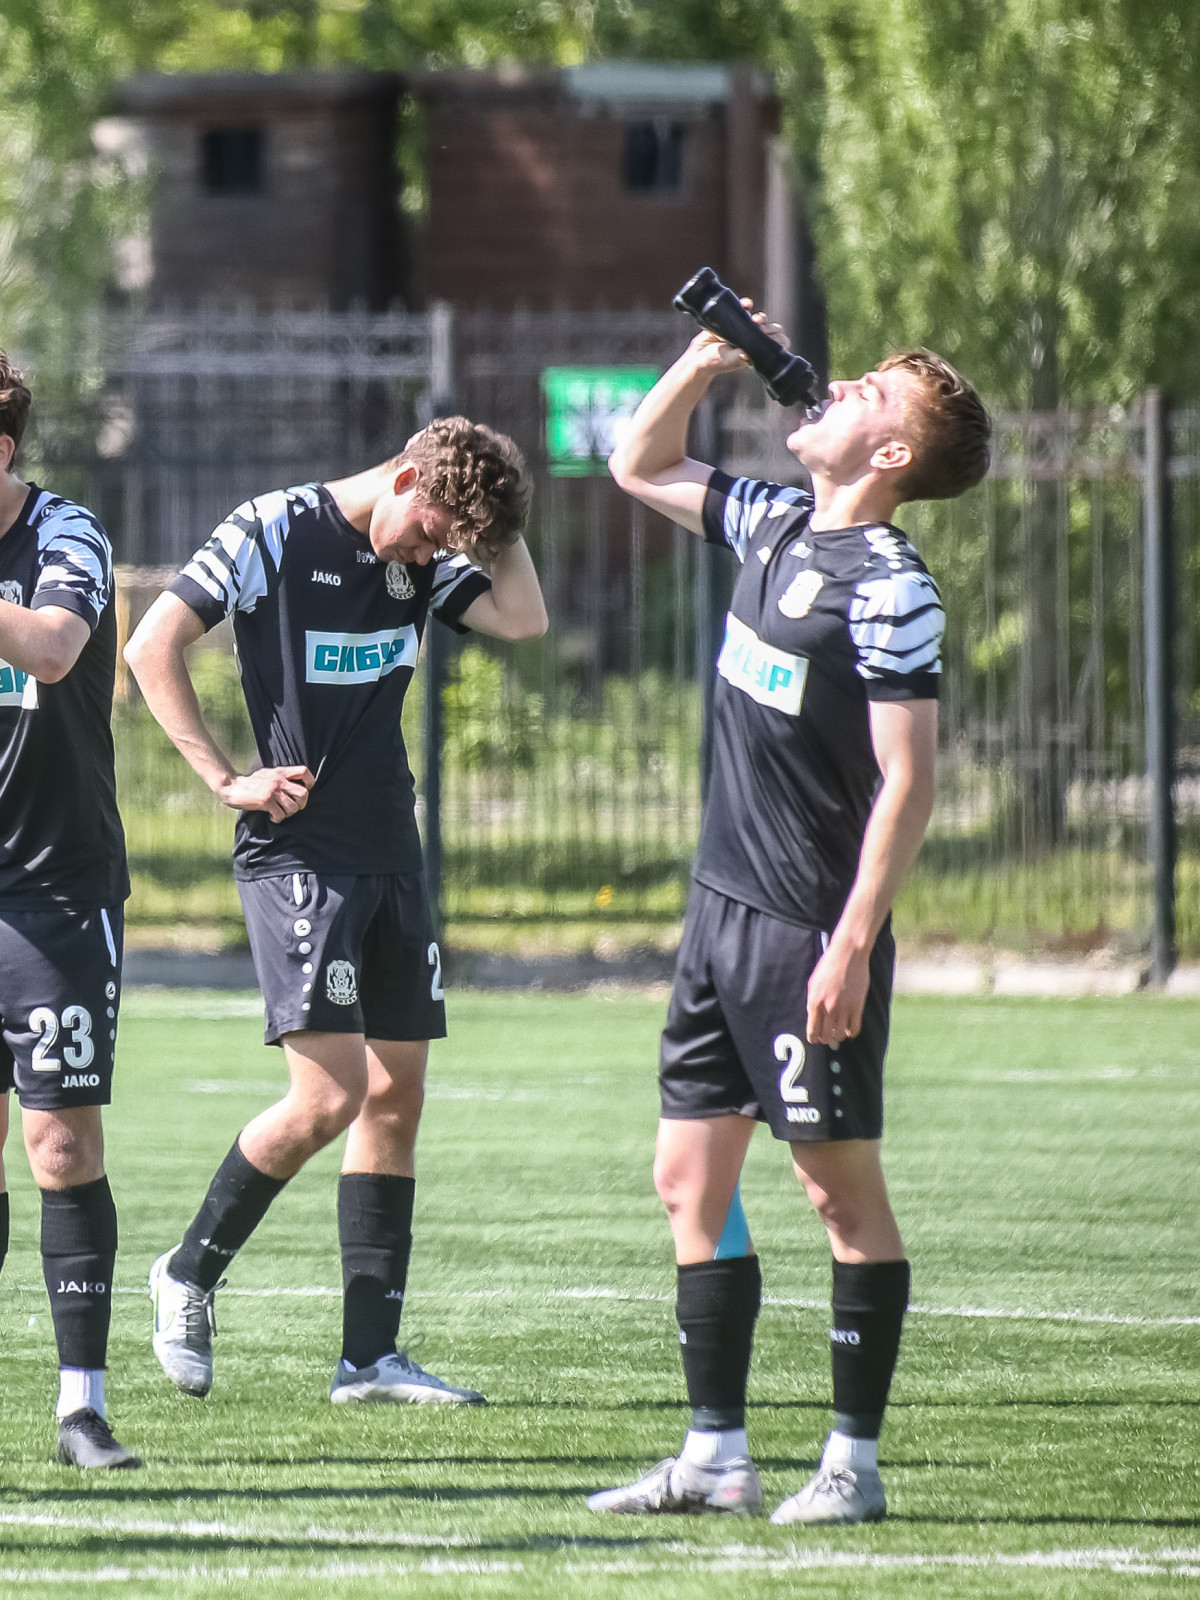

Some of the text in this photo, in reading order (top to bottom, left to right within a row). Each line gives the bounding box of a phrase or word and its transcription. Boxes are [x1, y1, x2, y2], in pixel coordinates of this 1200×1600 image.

[311, 570, 342, 587] JAKO
[28, 1005, 96, 1072] 23
[774, 1033, 809, 1103] 2
[62, 1074, 100, 1088] JAKO
[57, 1280, 106, 1294] JAKO
